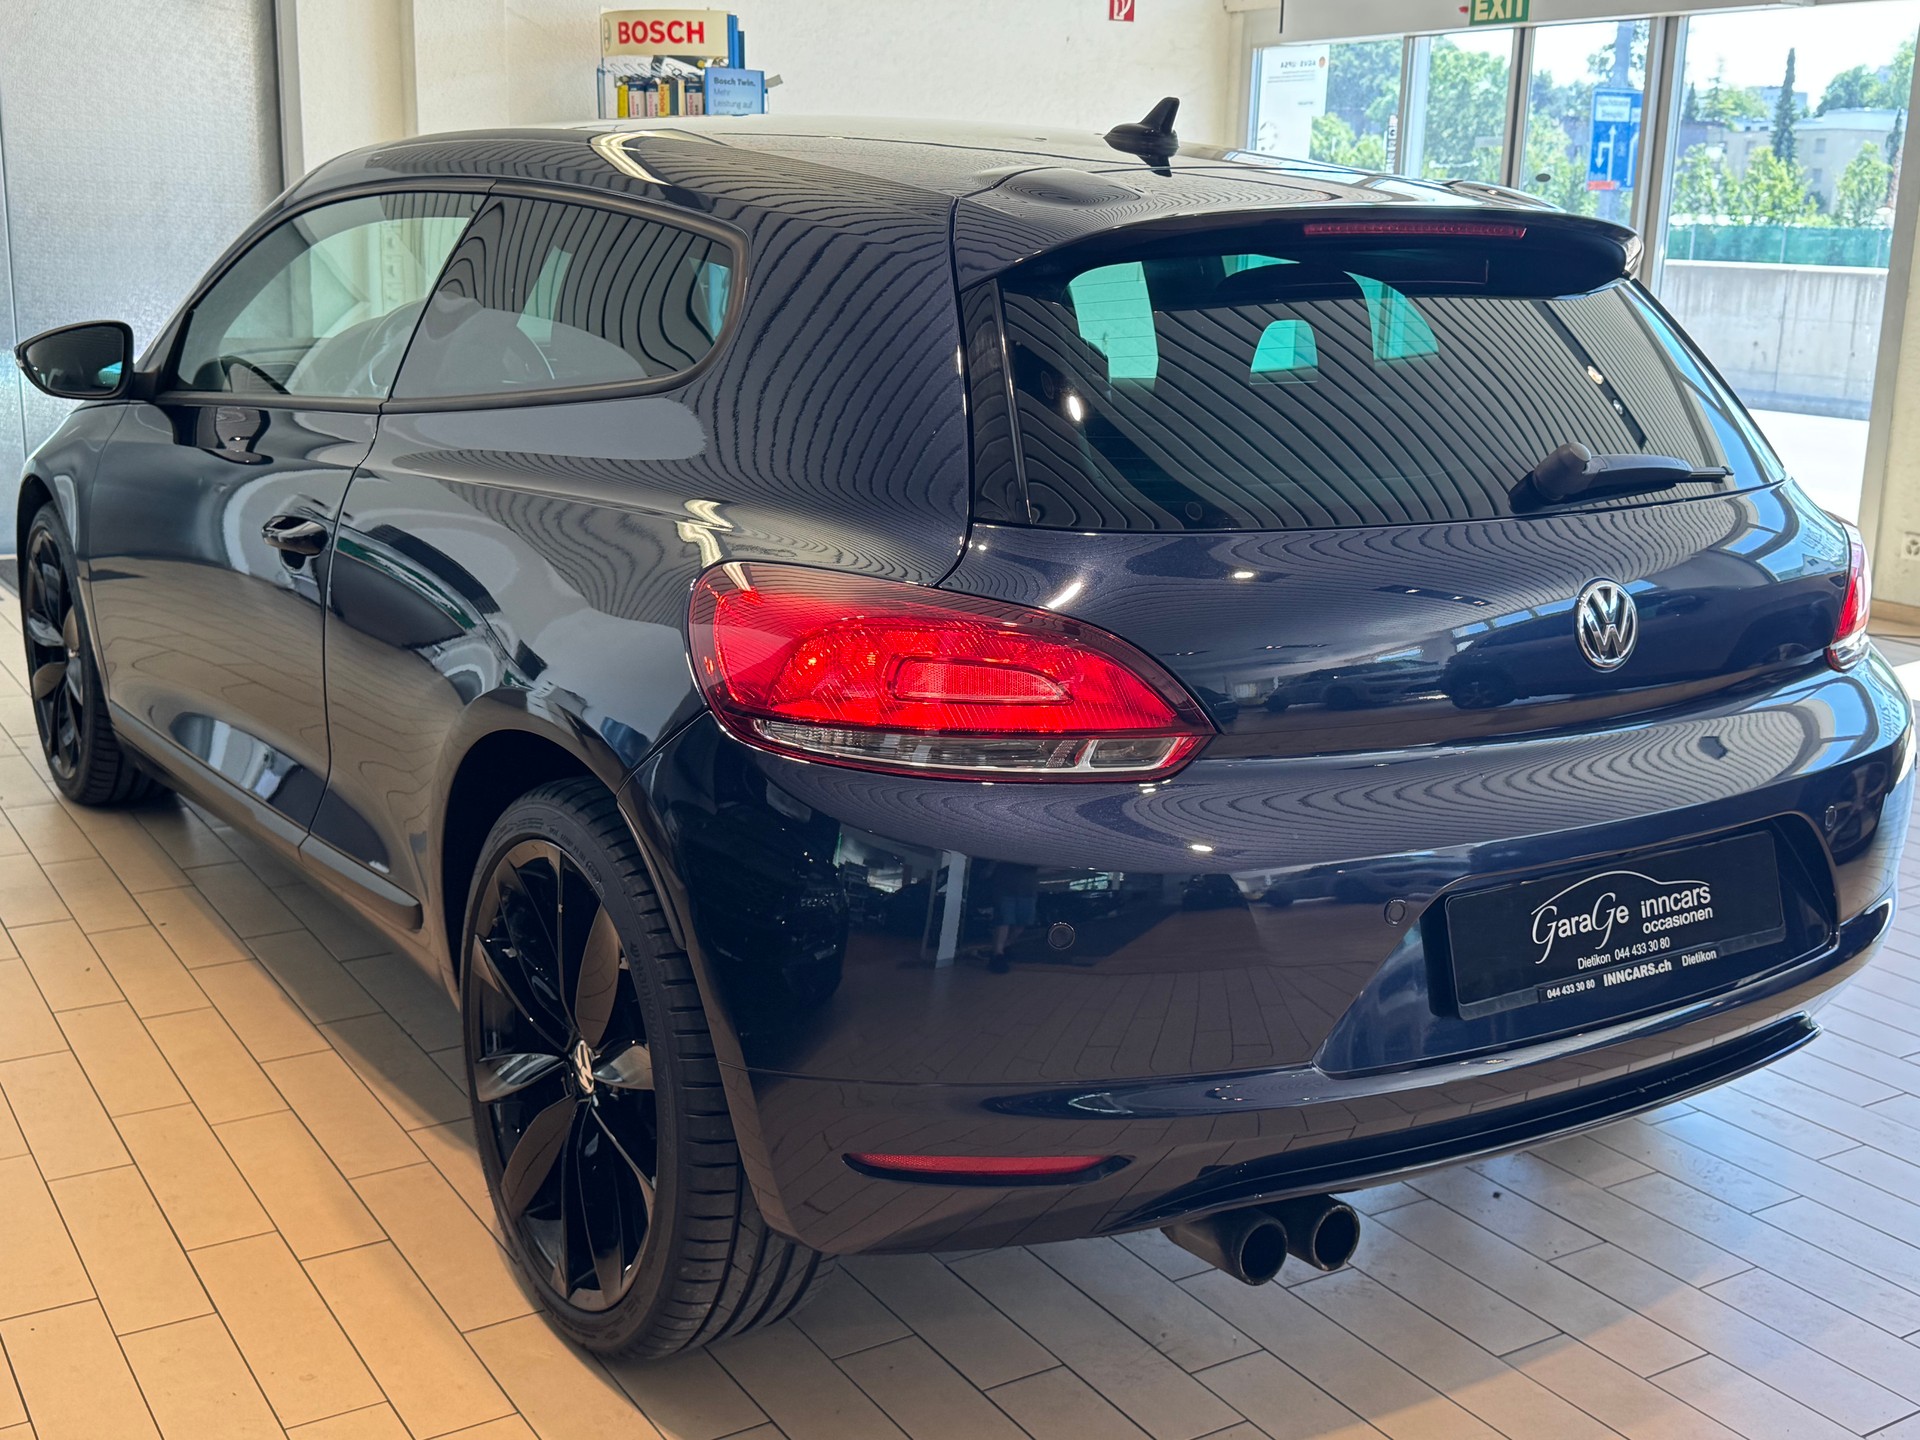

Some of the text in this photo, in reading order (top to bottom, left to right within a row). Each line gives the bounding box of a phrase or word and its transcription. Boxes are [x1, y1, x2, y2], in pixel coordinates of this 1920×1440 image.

[1474, 0, 1523, 21] EXIT
[618, 20, 705, 44] BOSCH
[714, 77, 736, 85] Bosch
[1580, 583, 1636, 663] VW
[1531, 886, 1711, 965] GaraGe inncars
[1642, 907, 1714, 934] occasionen
[1577, 936, 1671, 970] Dietikon 044 433 30 80
[1546, 950, 1717, 999] 044 433 30 80 INNCARS.ch Dietikon
